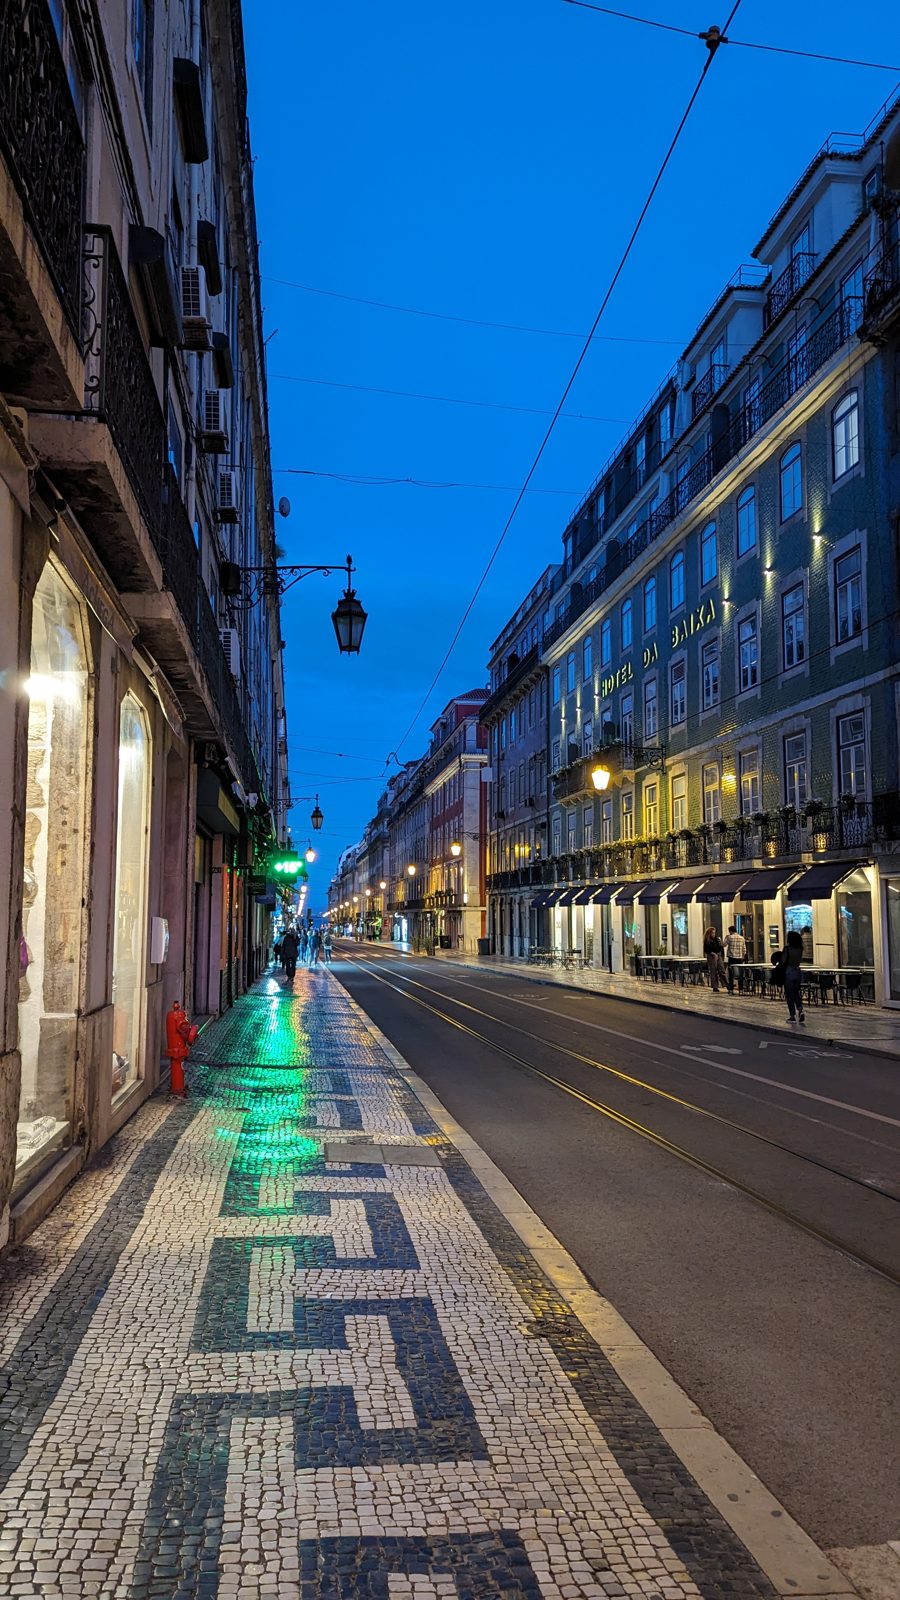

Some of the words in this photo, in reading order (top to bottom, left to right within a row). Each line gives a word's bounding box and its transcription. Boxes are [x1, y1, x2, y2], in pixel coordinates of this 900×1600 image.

[602, 661, 634, 697] HOTEL
[643, 642, 658, 668] DA
[672, 599, 716, 648] BAIXA
